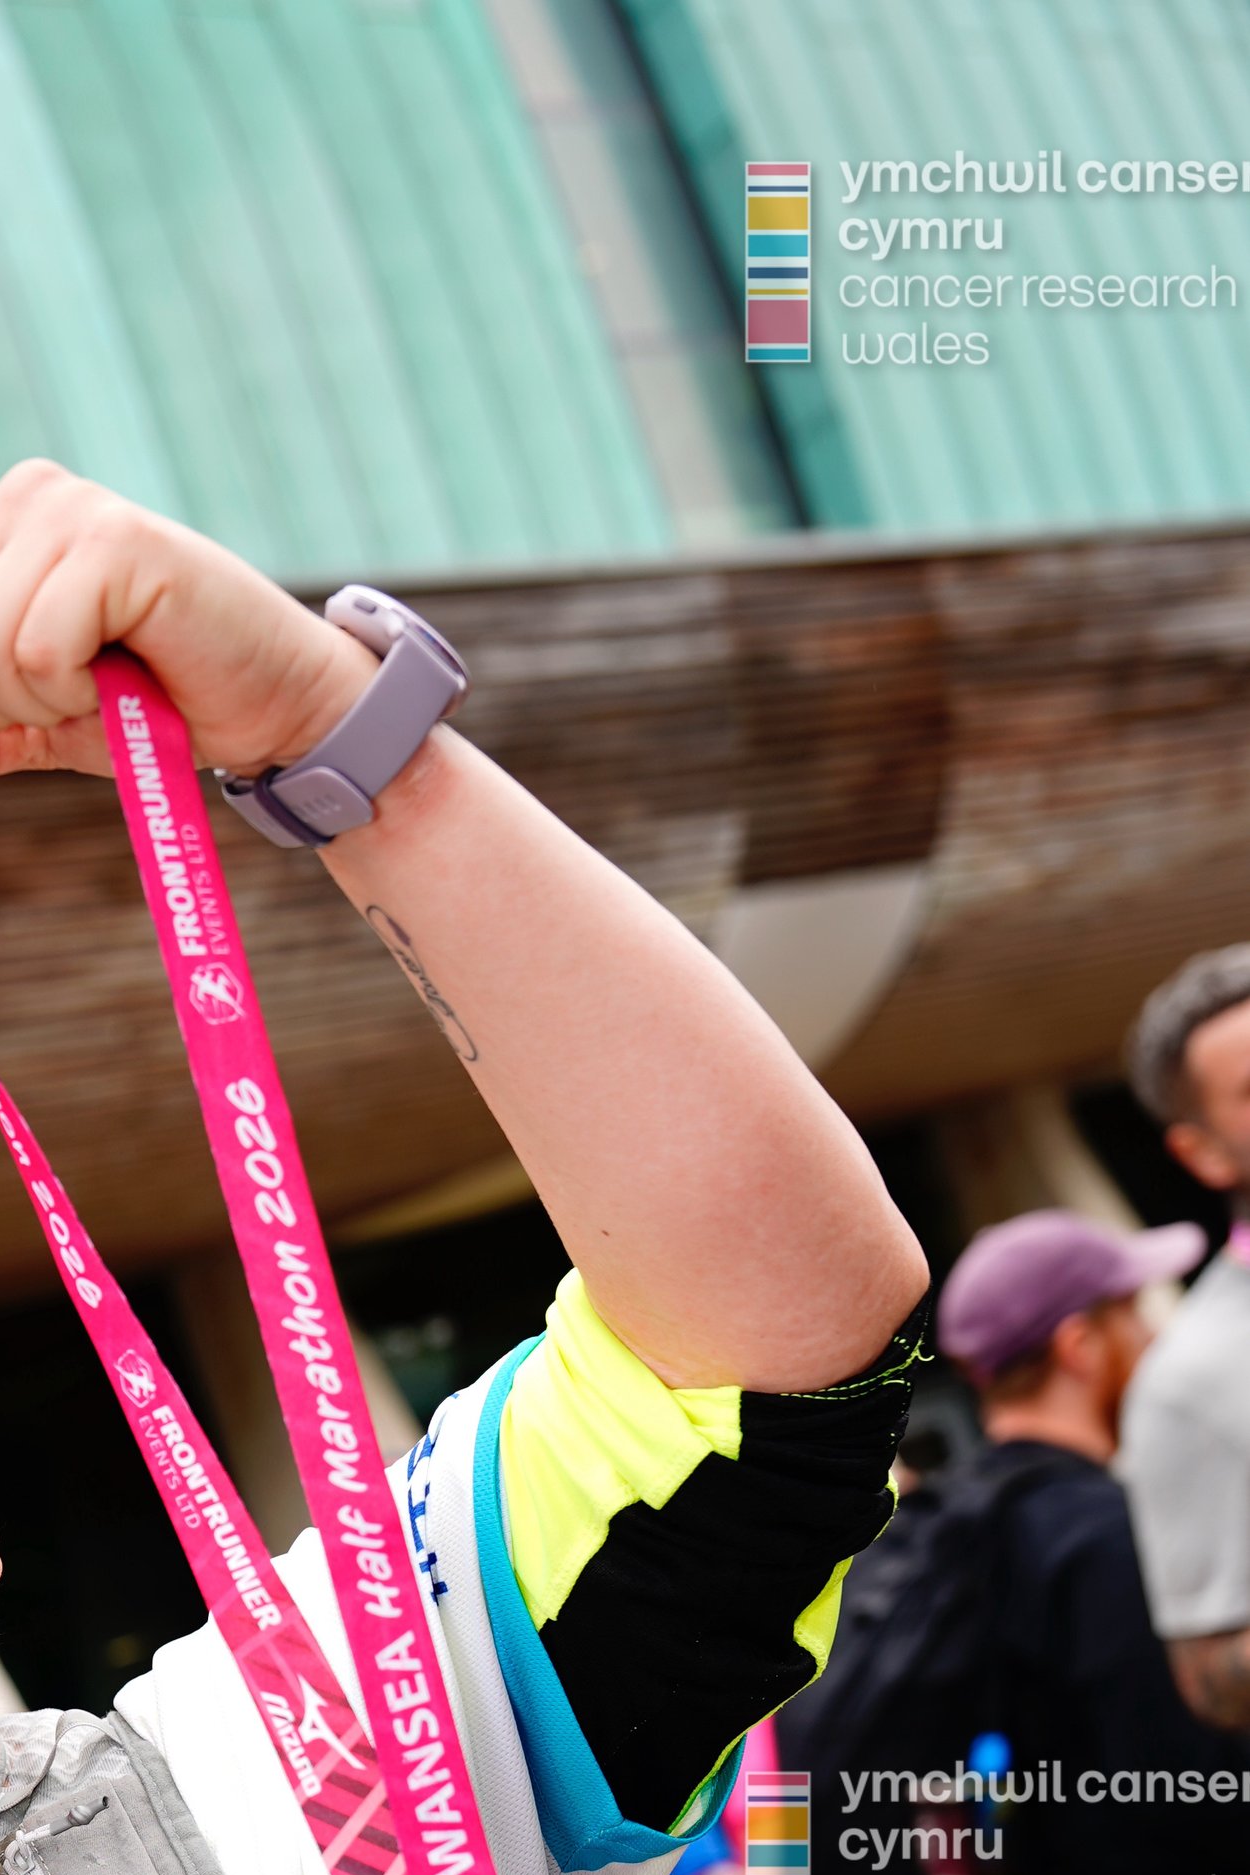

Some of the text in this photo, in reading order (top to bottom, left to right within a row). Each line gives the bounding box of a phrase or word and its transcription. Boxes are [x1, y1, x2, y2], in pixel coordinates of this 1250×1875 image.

[118, 694, 207, 957] FRONTRUNNER
[179, 824, 231, 957] EVENTS LTD
[224, 1076, 297, 1229] 2026
[31, 1180, 103, 1309] 2026
[274, 1241, 368, 1493] Marathon
[139, 1415, 202, 1531] EVENTS LTD
[151, 1404, 282, 1631] FRONTRUNNER
[337, 1505, 403, 1619] Half
